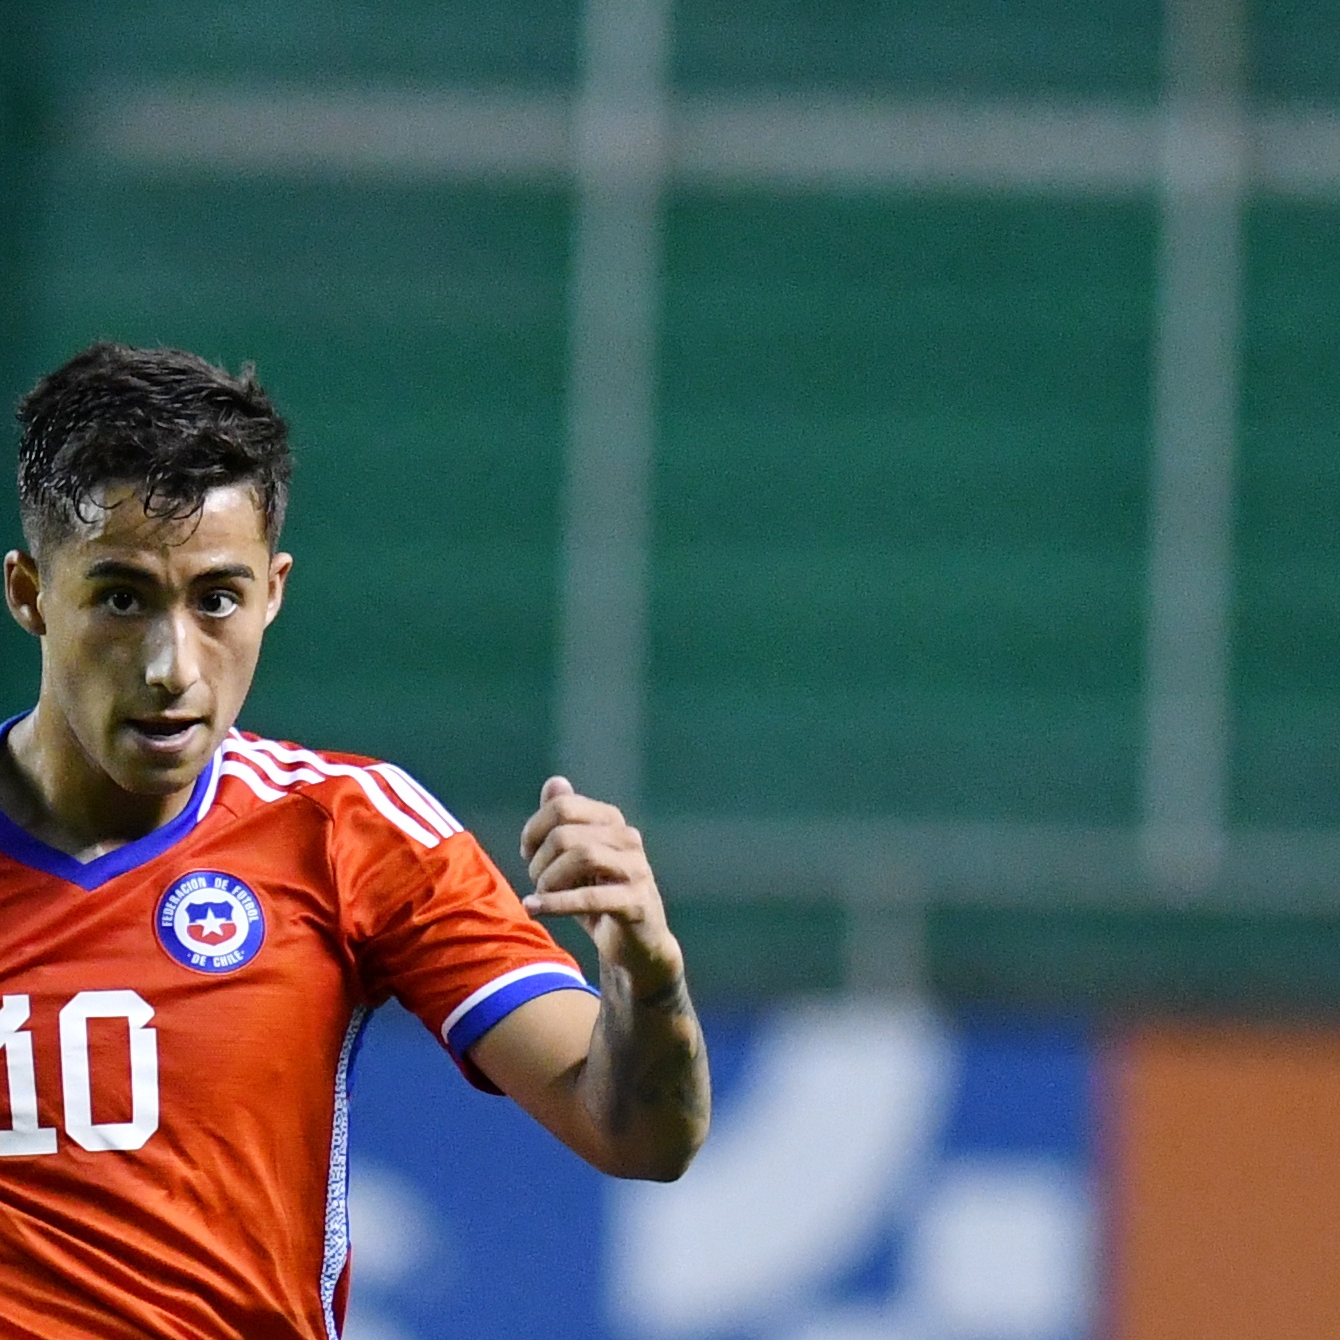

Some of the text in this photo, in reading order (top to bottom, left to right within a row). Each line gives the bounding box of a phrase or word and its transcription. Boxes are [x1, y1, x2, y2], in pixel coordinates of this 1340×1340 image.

[161, 877, 259, 927] FEDERACION DE FUTBOL
[190, 950, 245, 968] DE CHILE
